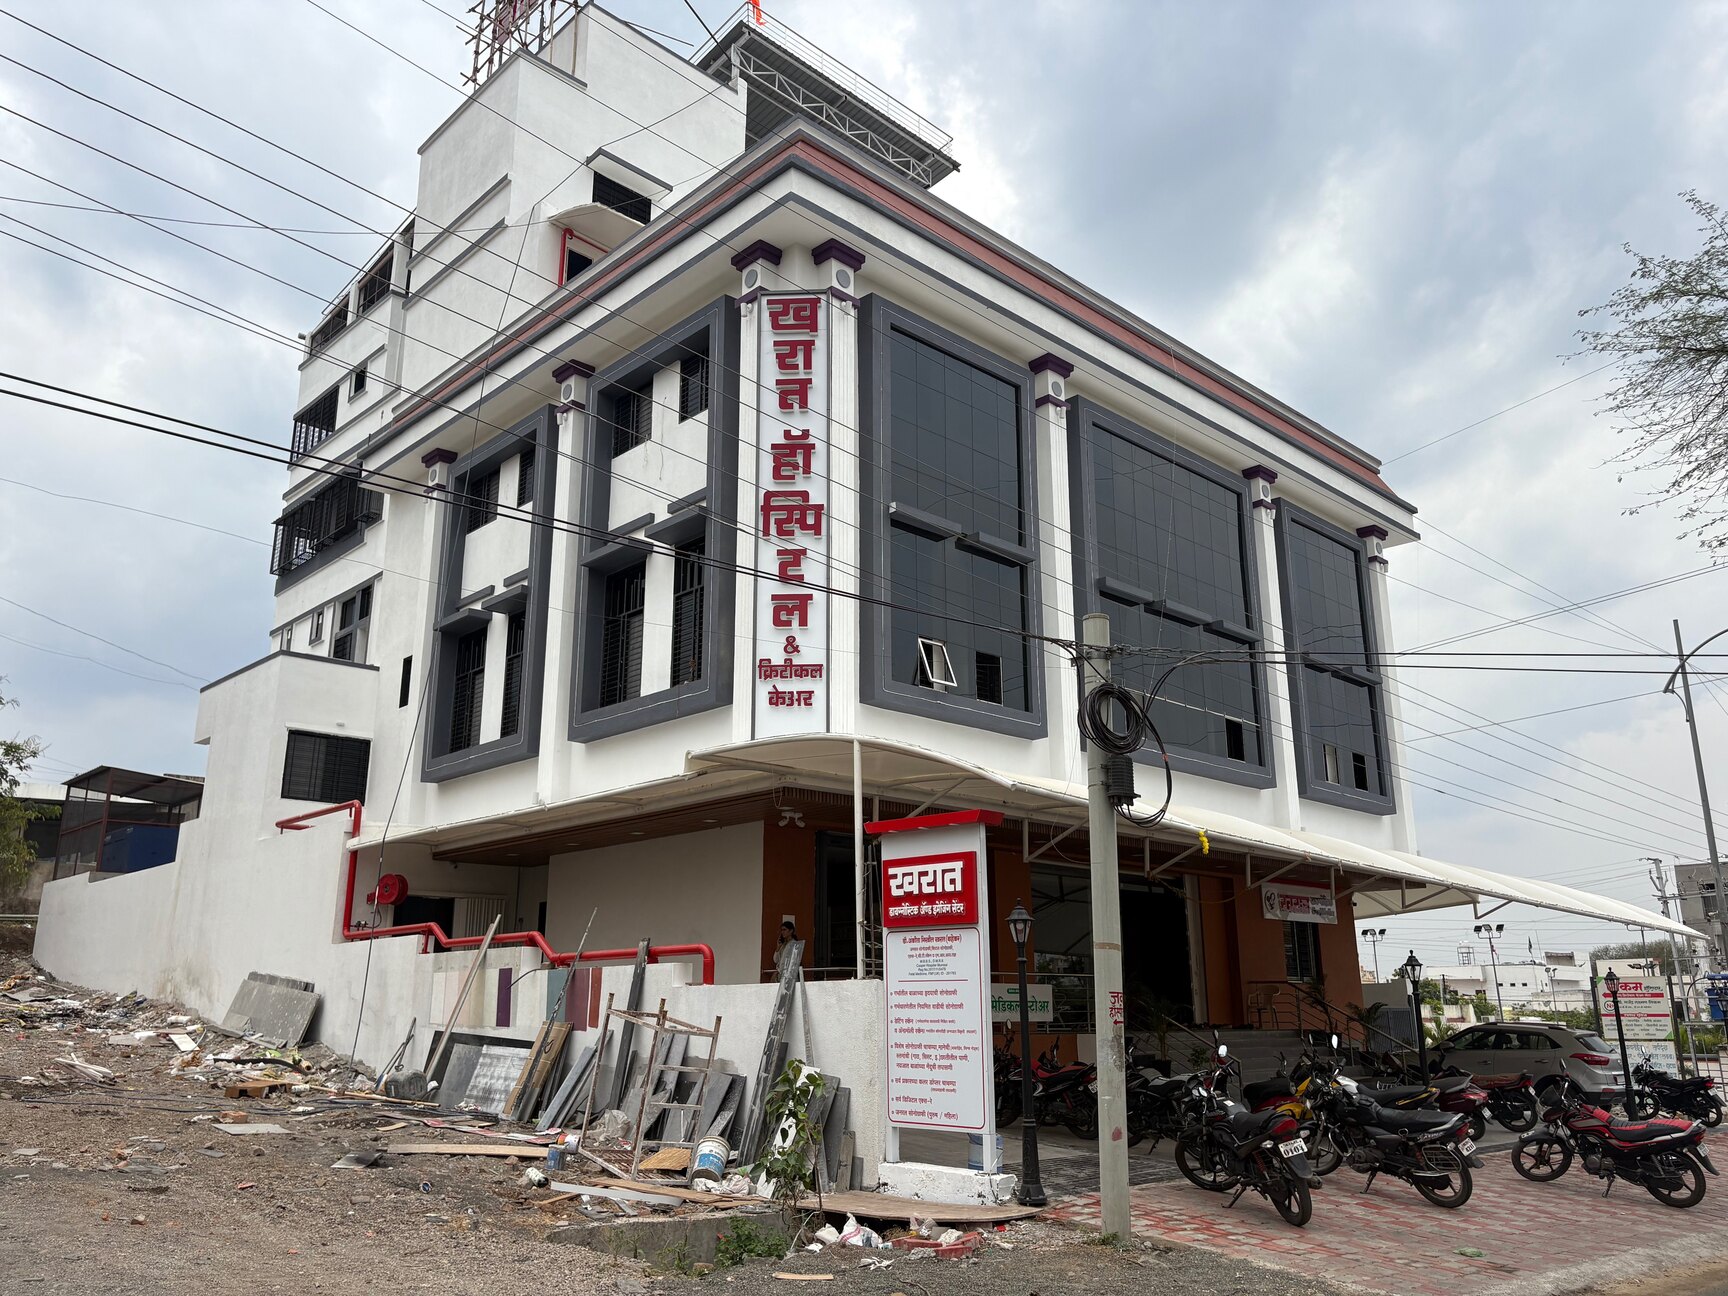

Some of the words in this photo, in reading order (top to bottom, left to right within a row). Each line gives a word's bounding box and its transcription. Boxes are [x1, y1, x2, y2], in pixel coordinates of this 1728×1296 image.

[766, 297, 821, 413] खरात
[760, 428, 824, 631] हॉस्पिटल
[782, 634, 800, 655] &
[757, 658, 824, 681] क्रिटीकल
[768, 684, 815, 708] केअर
[888, 861, 963, 896] खरात
